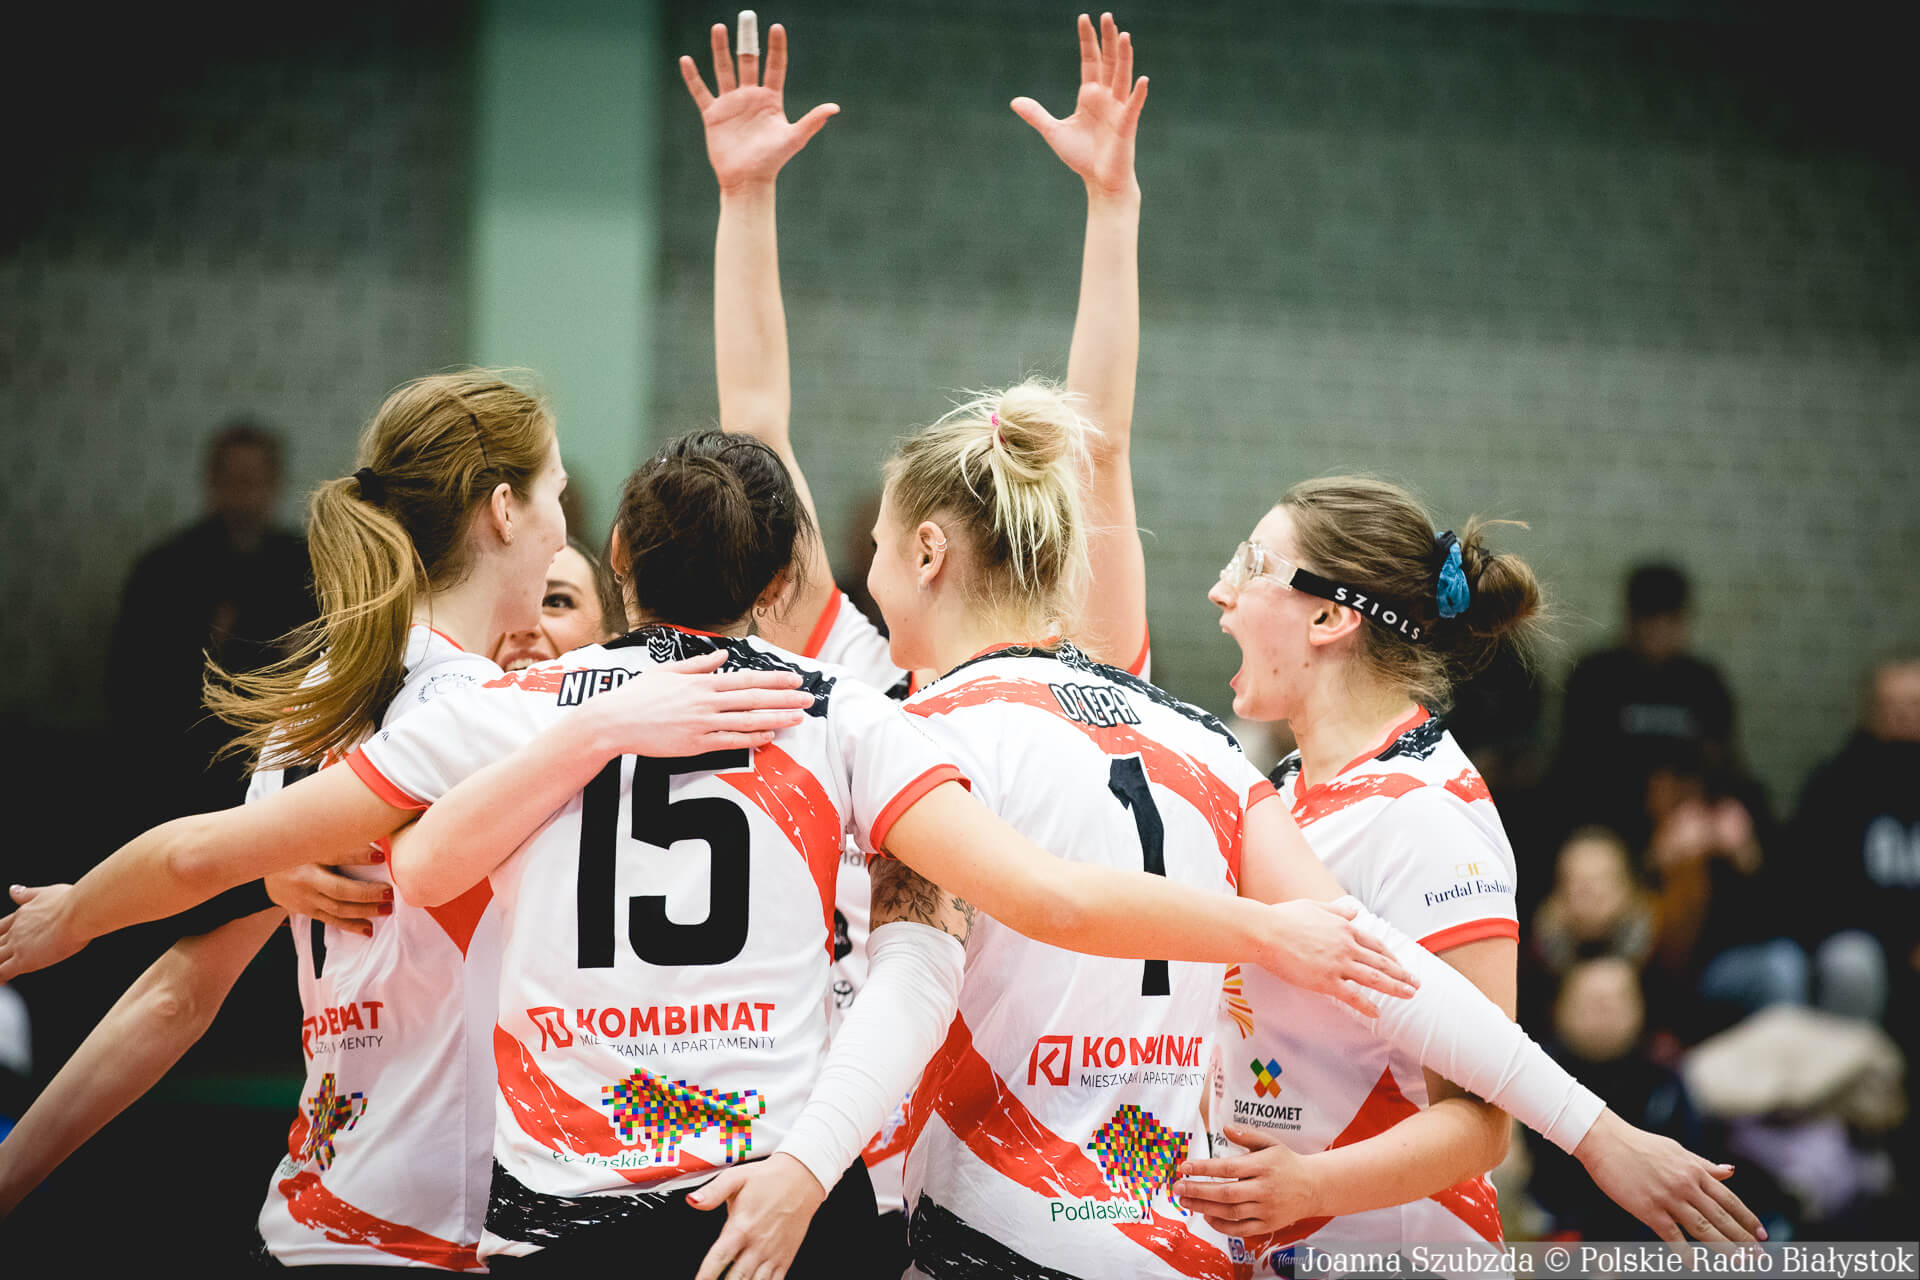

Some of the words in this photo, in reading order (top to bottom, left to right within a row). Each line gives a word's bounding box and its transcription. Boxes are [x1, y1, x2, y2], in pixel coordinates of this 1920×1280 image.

[1334, 587, 1420, 640] SZIOLS
[577, 747, 751, 969] 15
[1107, 756, 1171, 997] 1
[1424, 880, 1472, 907] Furdal
[576, 1002, 775, 1038] KOMBINAT
[672, 1036, 776, 1054] APARTAMENTY
[1234, 1099, 1303, 1121] SIATKOMET
[1249, 1116, 1302, 1131] Ogrodzeniowe
[1051, 1200, 1140, 1222] Podlaskie
